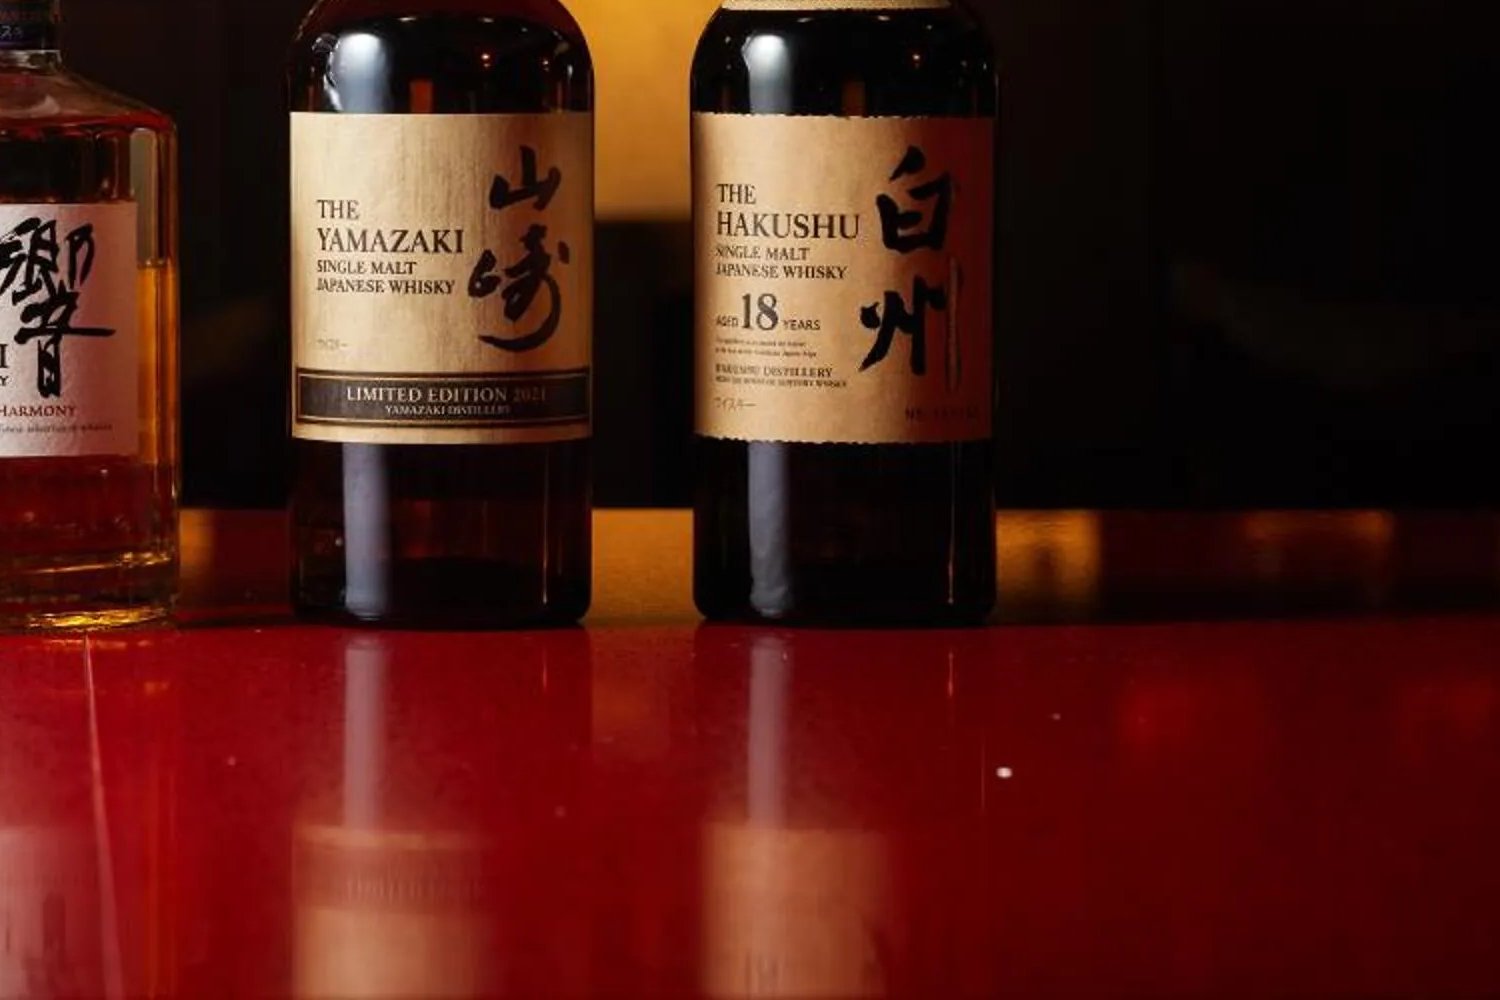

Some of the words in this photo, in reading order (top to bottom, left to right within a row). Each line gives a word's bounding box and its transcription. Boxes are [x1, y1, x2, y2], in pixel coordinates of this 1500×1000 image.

[716, 184, 756, 204] THE
[317, 200, 359, 220] THE
[716, 211, 860, 239] HAKUSHU
[317, 228, 464, 253] YAMAZAKI
[766, 247, 810, 261] MALT
[317, 259, 366, 274] SINGLE
[371, 261, 417, 275] MALT
[715, 264, 779, 279] JAPANESE
[783, 265, 848, 280] WHISKY
[316, 277, 384, 294] JAPANESE
[389, 279, 455, 295] WHISKY
[716, 316, 738, 328] AGED
[741, 293, 779, 331] 18
[783, 319, 821, 331] YEARS
[763, 365, 833, 378] DISTILLERY
[346, 386, 421, 403] LIMITED
[429, 387, 507, 403] EDITION
[385, 405, 446, 416] YAMAZAKI
